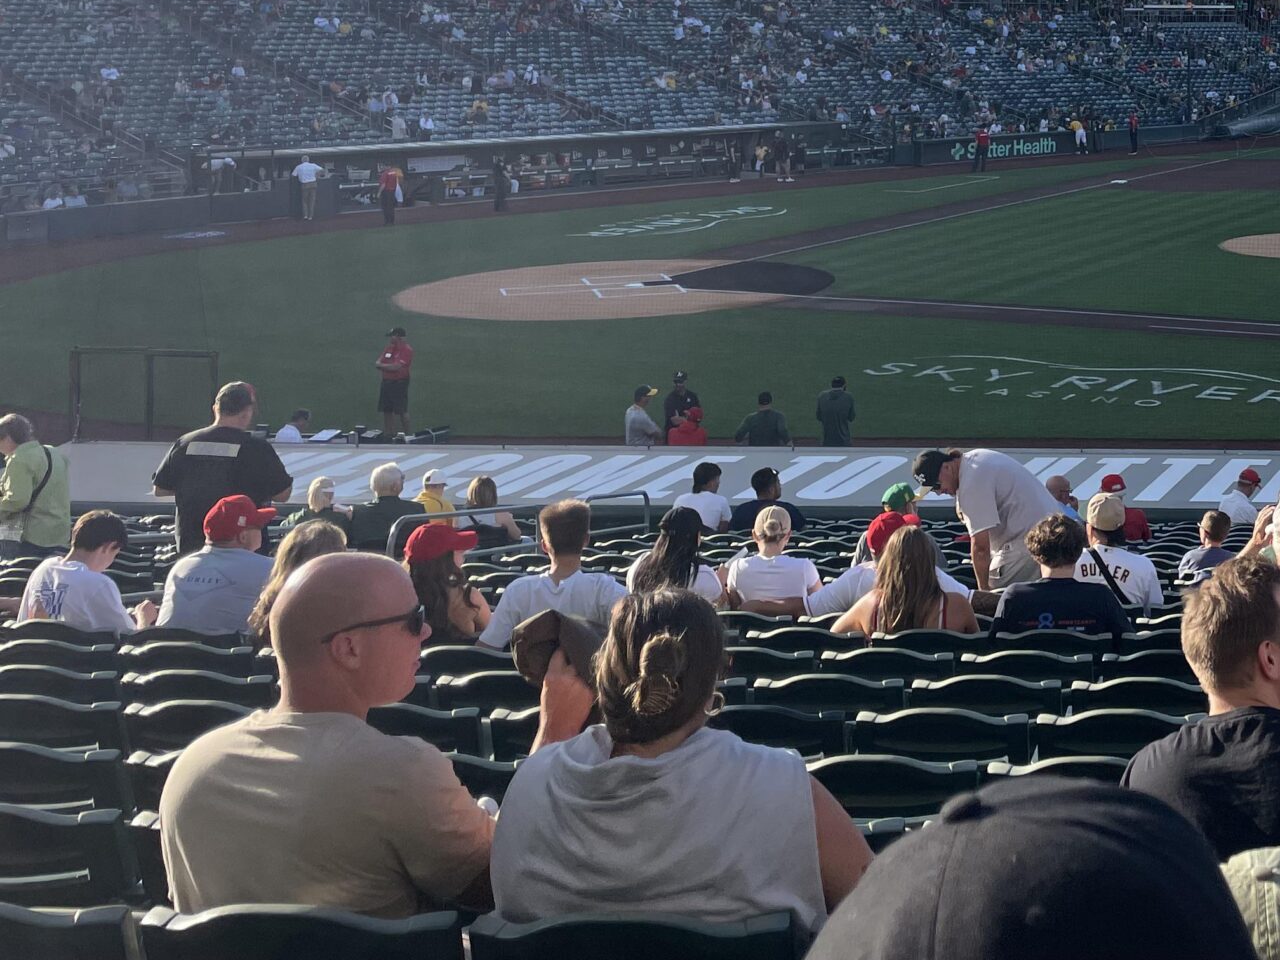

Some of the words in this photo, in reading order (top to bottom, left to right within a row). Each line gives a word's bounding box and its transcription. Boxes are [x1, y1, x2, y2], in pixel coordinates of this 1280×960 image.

[967, 141, 1011, 159] Stter
[1013, 137, 1056, 155] Health
[863, 362, 1034, 382] SKY
[948, 384, 1162, 408] CASINO
[732, 455, 908, 500] TO
[1080, 562, 1130, 584] BUER
